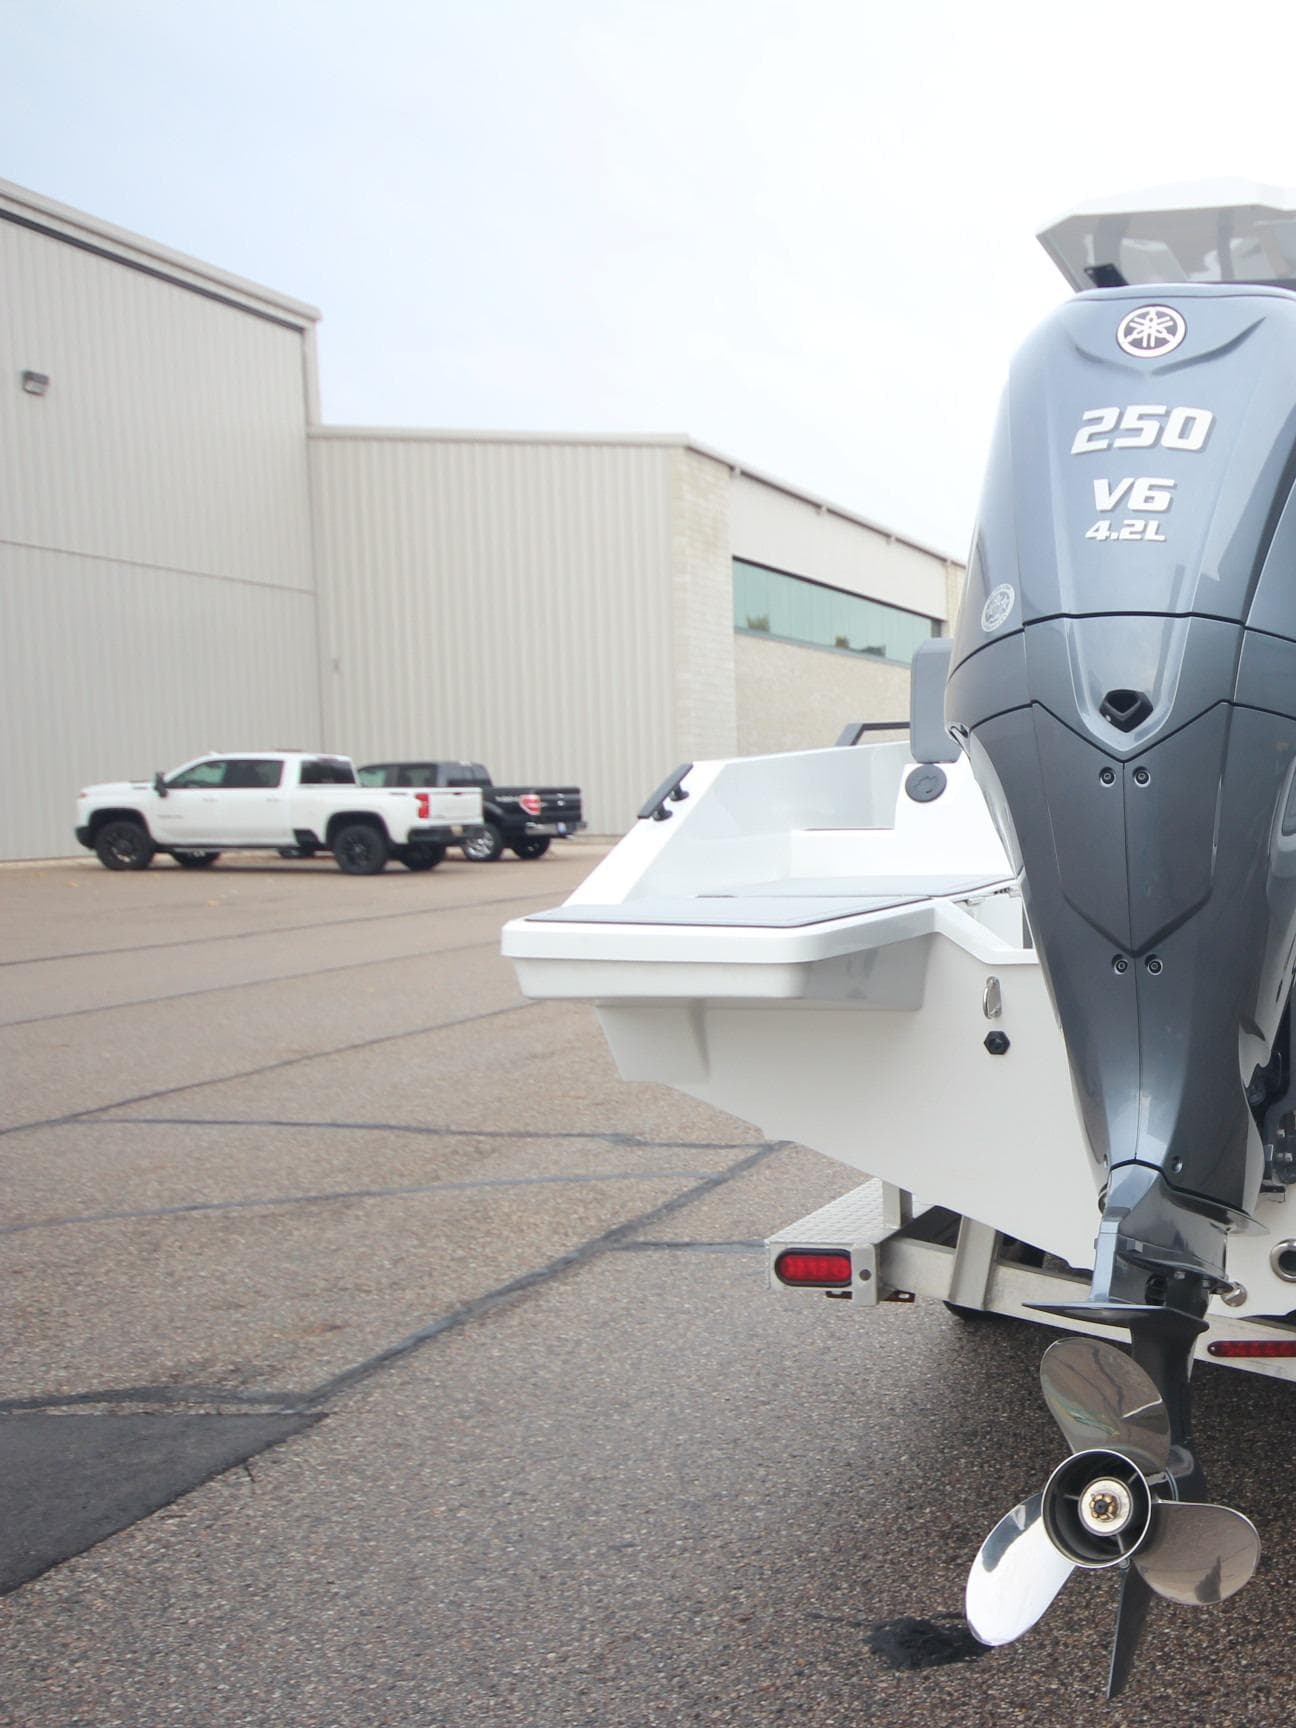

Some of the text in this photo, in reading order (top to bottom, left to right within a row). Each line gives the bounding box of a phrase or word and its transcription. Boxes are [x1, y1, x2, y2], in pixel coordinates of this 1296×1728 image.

[1070, 404, 1215, 455] 250
[1093, 477, 1176, 513] V6
[1084, 519, 1167, 542] 4.2L
